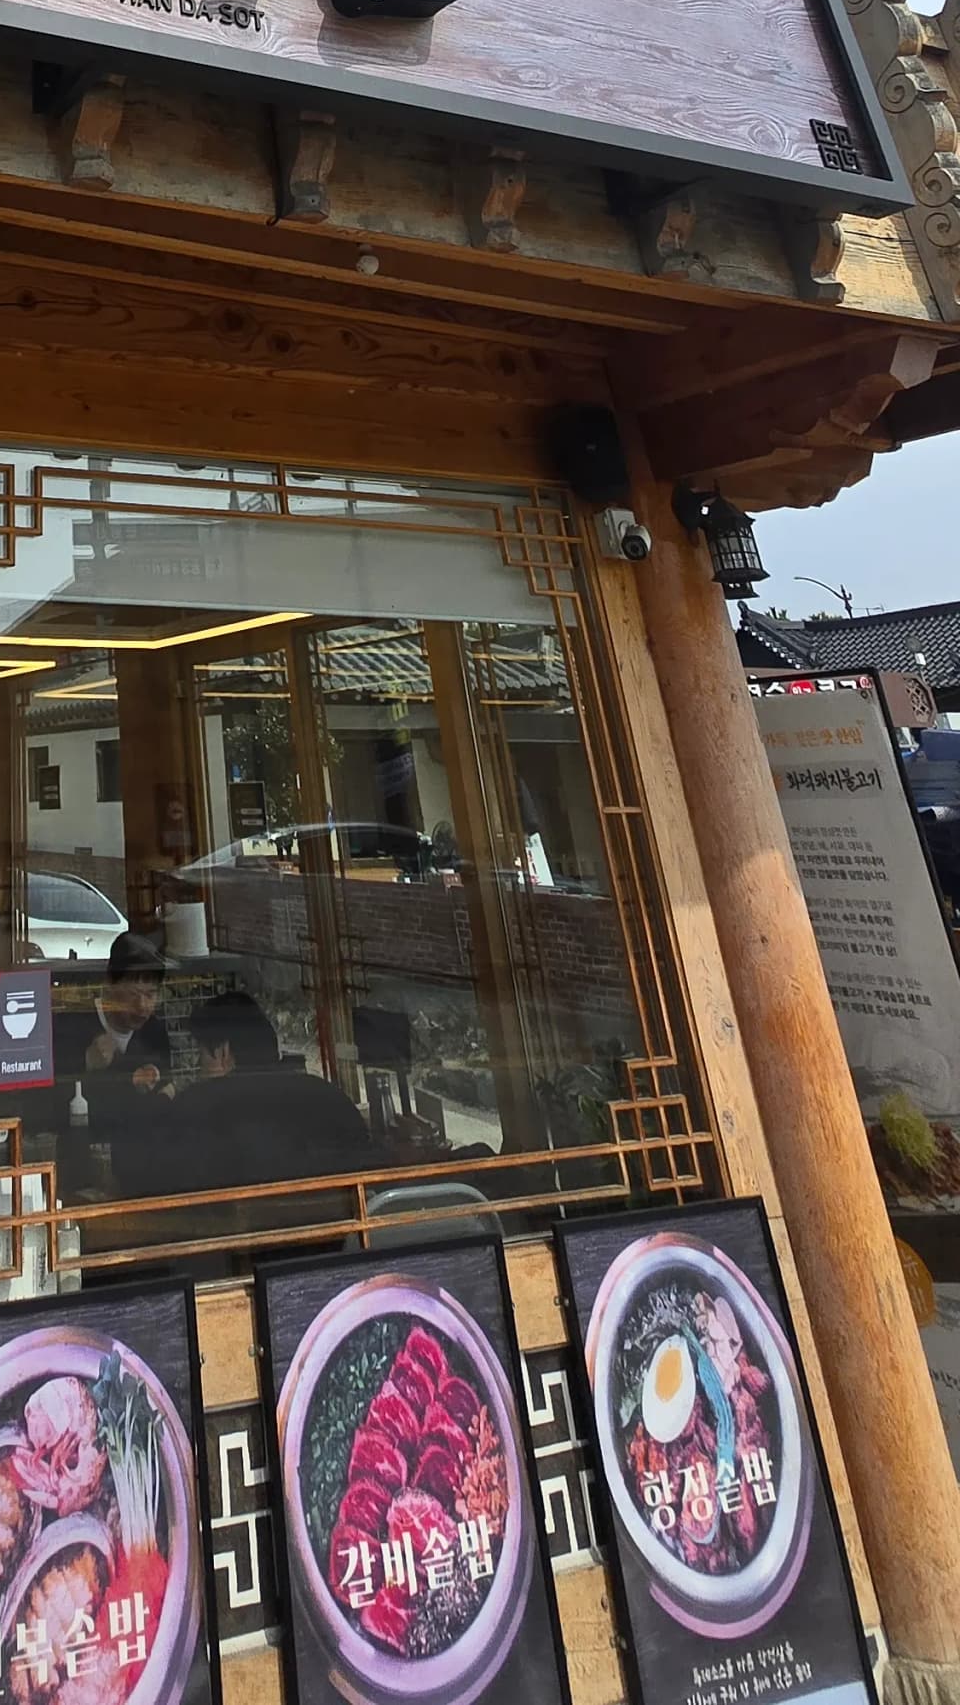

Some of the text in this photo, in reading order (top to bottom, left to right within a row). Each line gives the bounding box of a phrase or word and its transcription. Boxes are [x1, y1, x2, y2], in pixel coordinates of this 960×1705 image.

[218, 2, 266, 33] SOT
[1, 1059, 42, 1074] Restaurant
[640, 1447, 777, 1531] 항정솥밥
[337, 1515, 495, 1610] 갈비솥밥
